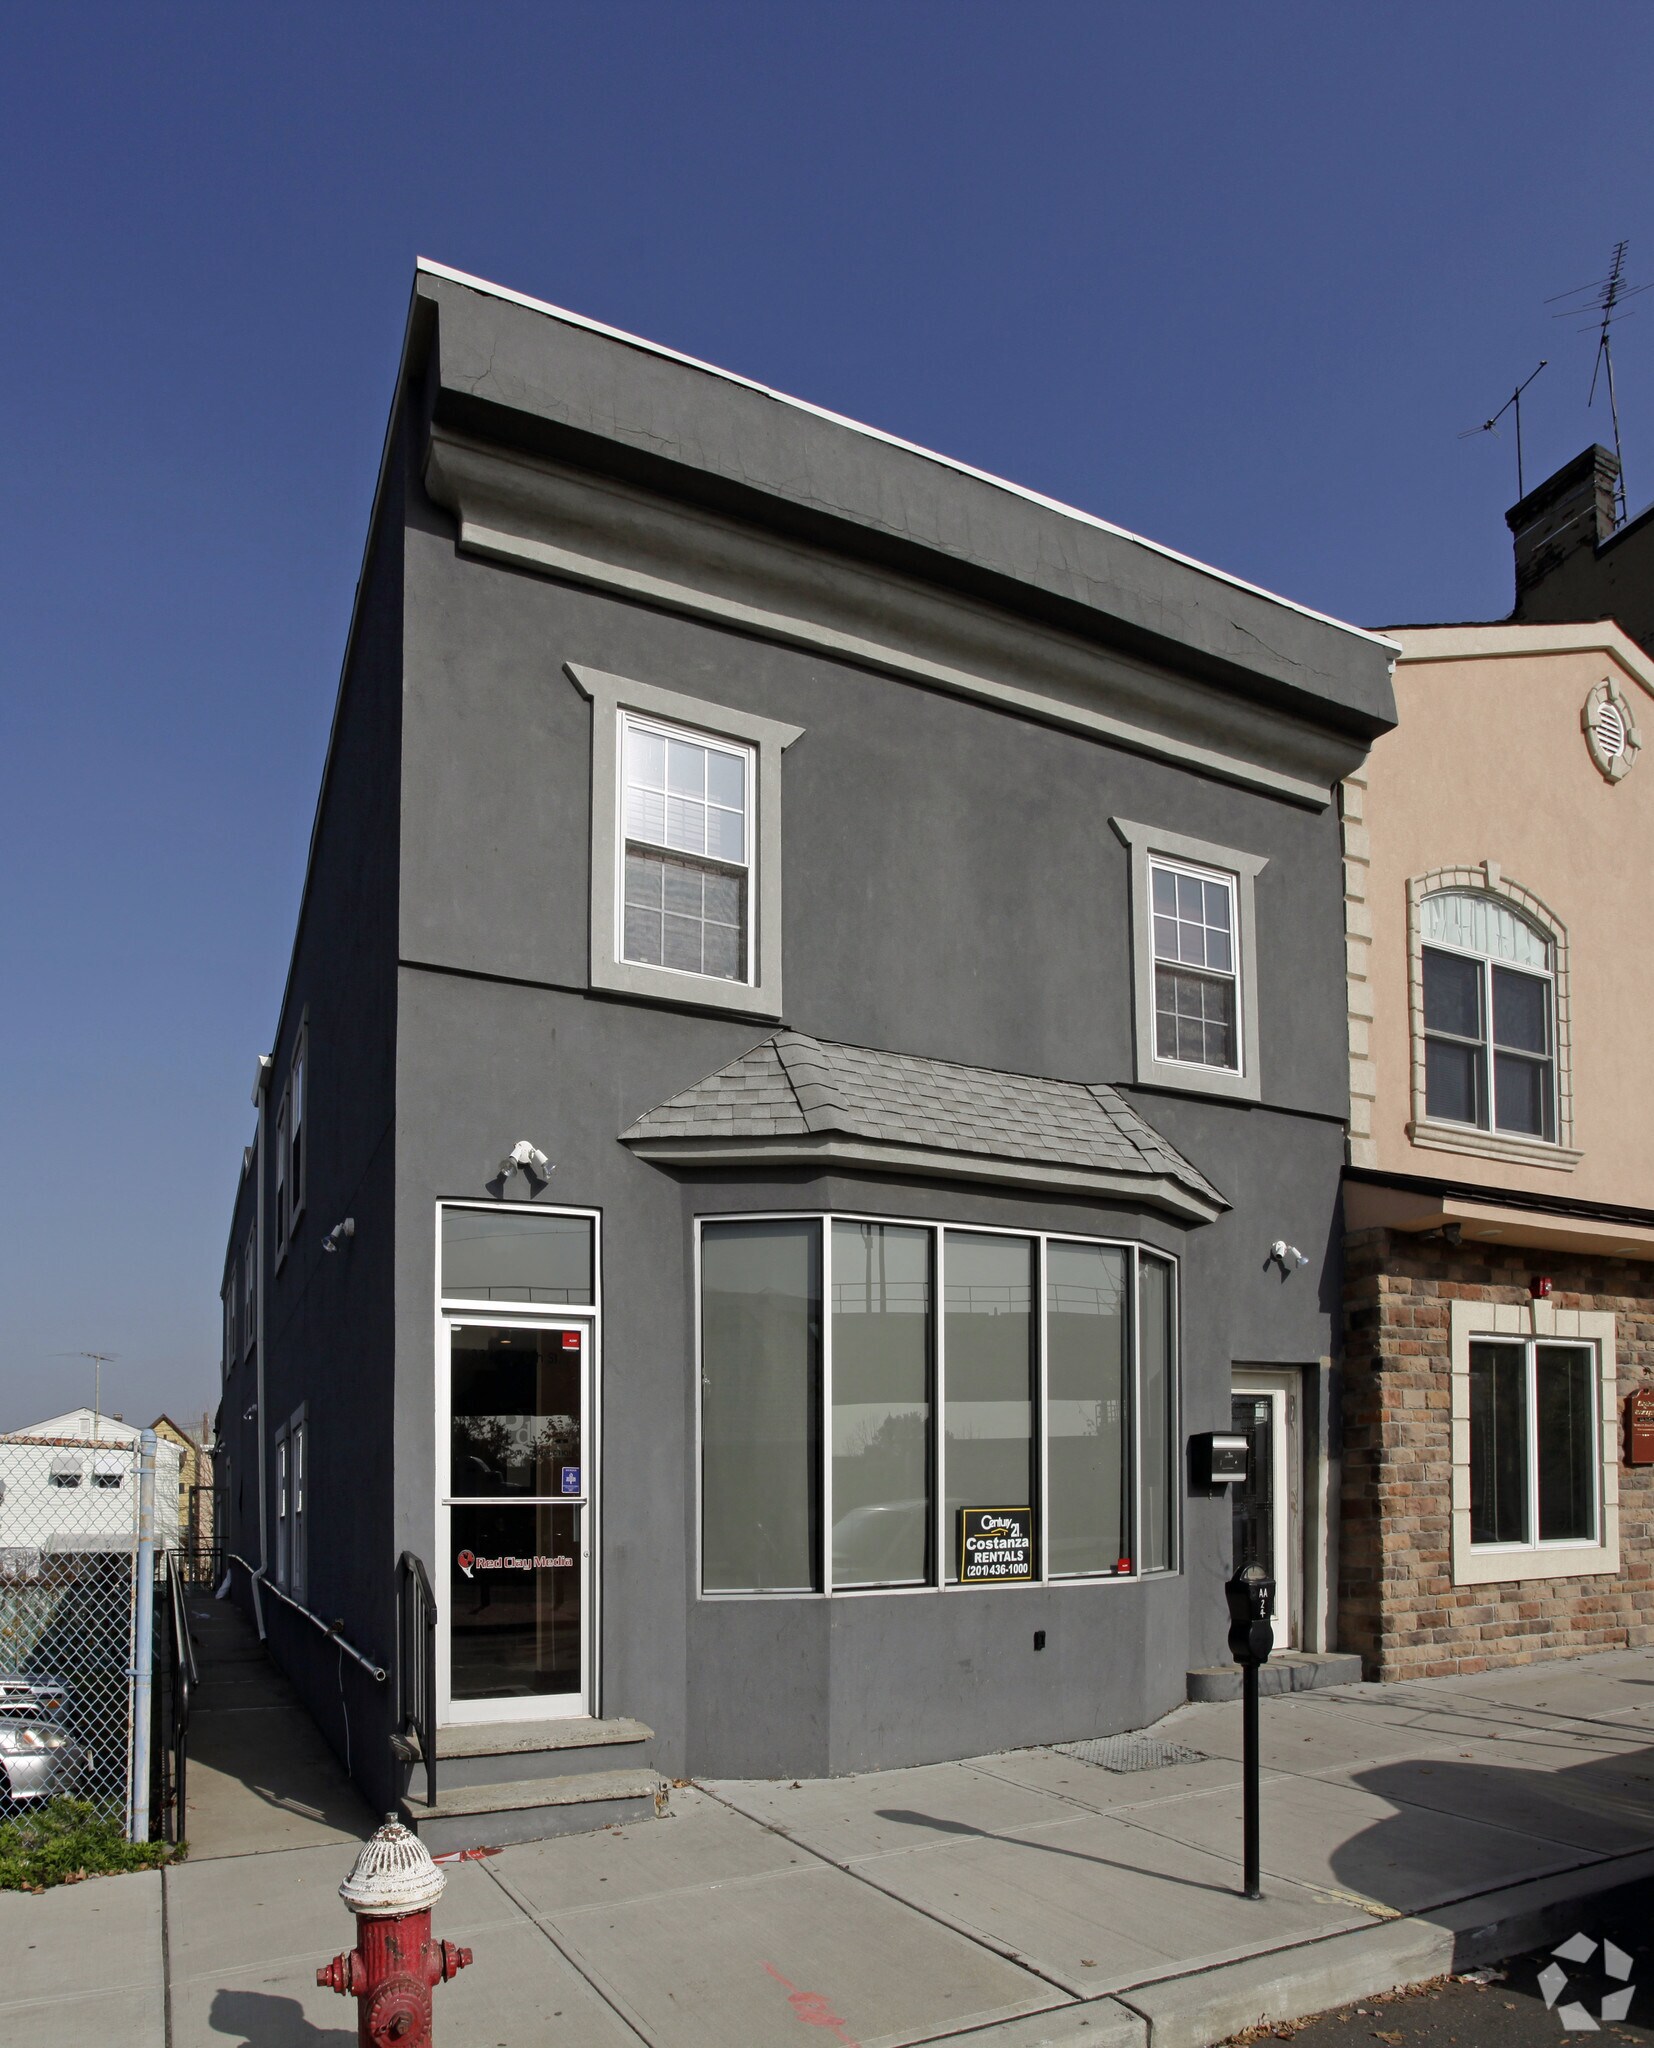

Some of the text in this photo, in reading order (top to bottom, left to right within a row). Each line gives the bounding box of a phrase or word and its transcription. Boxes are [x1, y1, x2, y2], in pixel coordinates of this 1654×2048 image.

[981, 1514, 1020, 1537] Century 21
[966, 1537, 1029, 1550] Costanza
[476, 1555, 574, 1570] Red Clay Media
[974, 1550, 1024, 1563] RENTALS
[967, 1563, 1028, 1577] (201) 436-1000
[1258, 1588, 1268, 1598] AA
